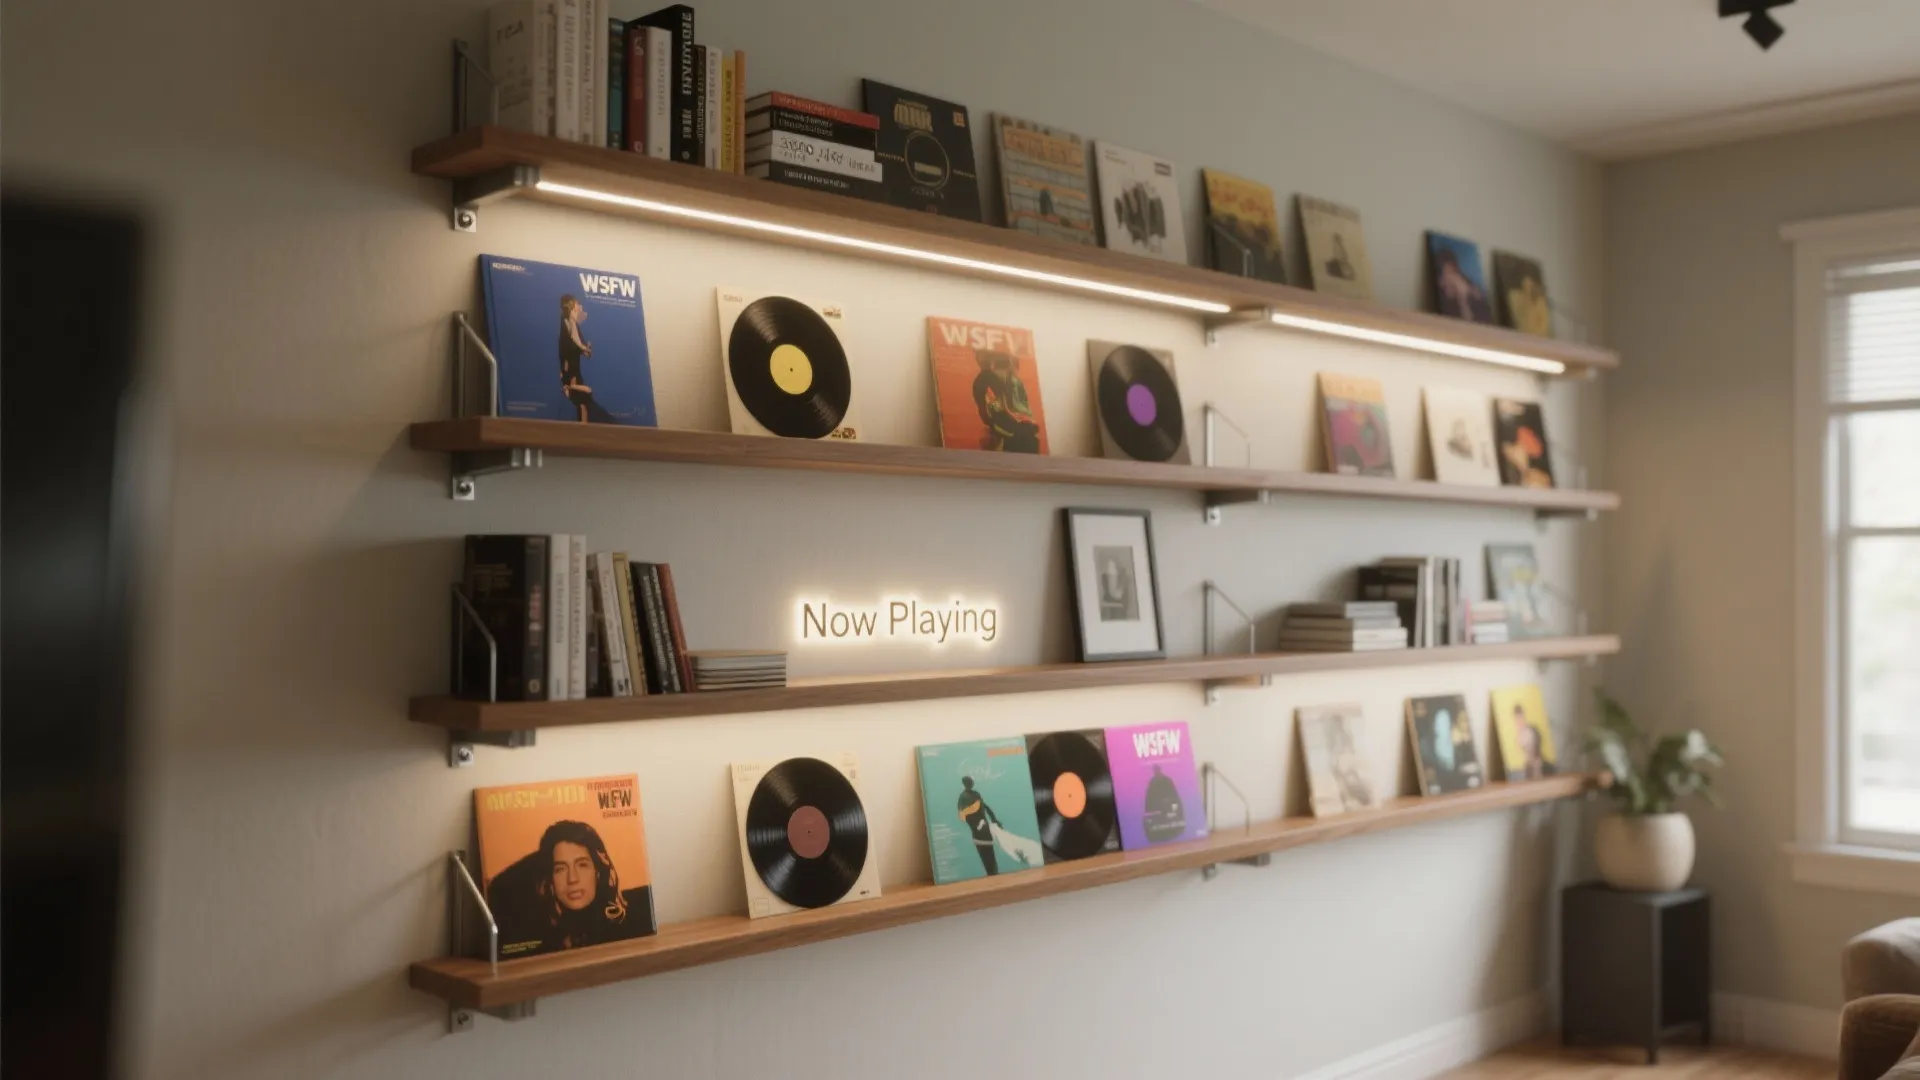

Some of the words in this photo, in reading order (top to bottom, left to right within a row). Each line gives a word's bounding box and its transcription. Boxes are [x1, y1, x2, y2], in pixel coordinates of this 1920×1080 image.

[579, 273, 636, 298] WSFW
[803, 602, 877, 638] Now
[889, 600, 997, 643] Playing
[1132, 729, 1181, 759] WSFW
